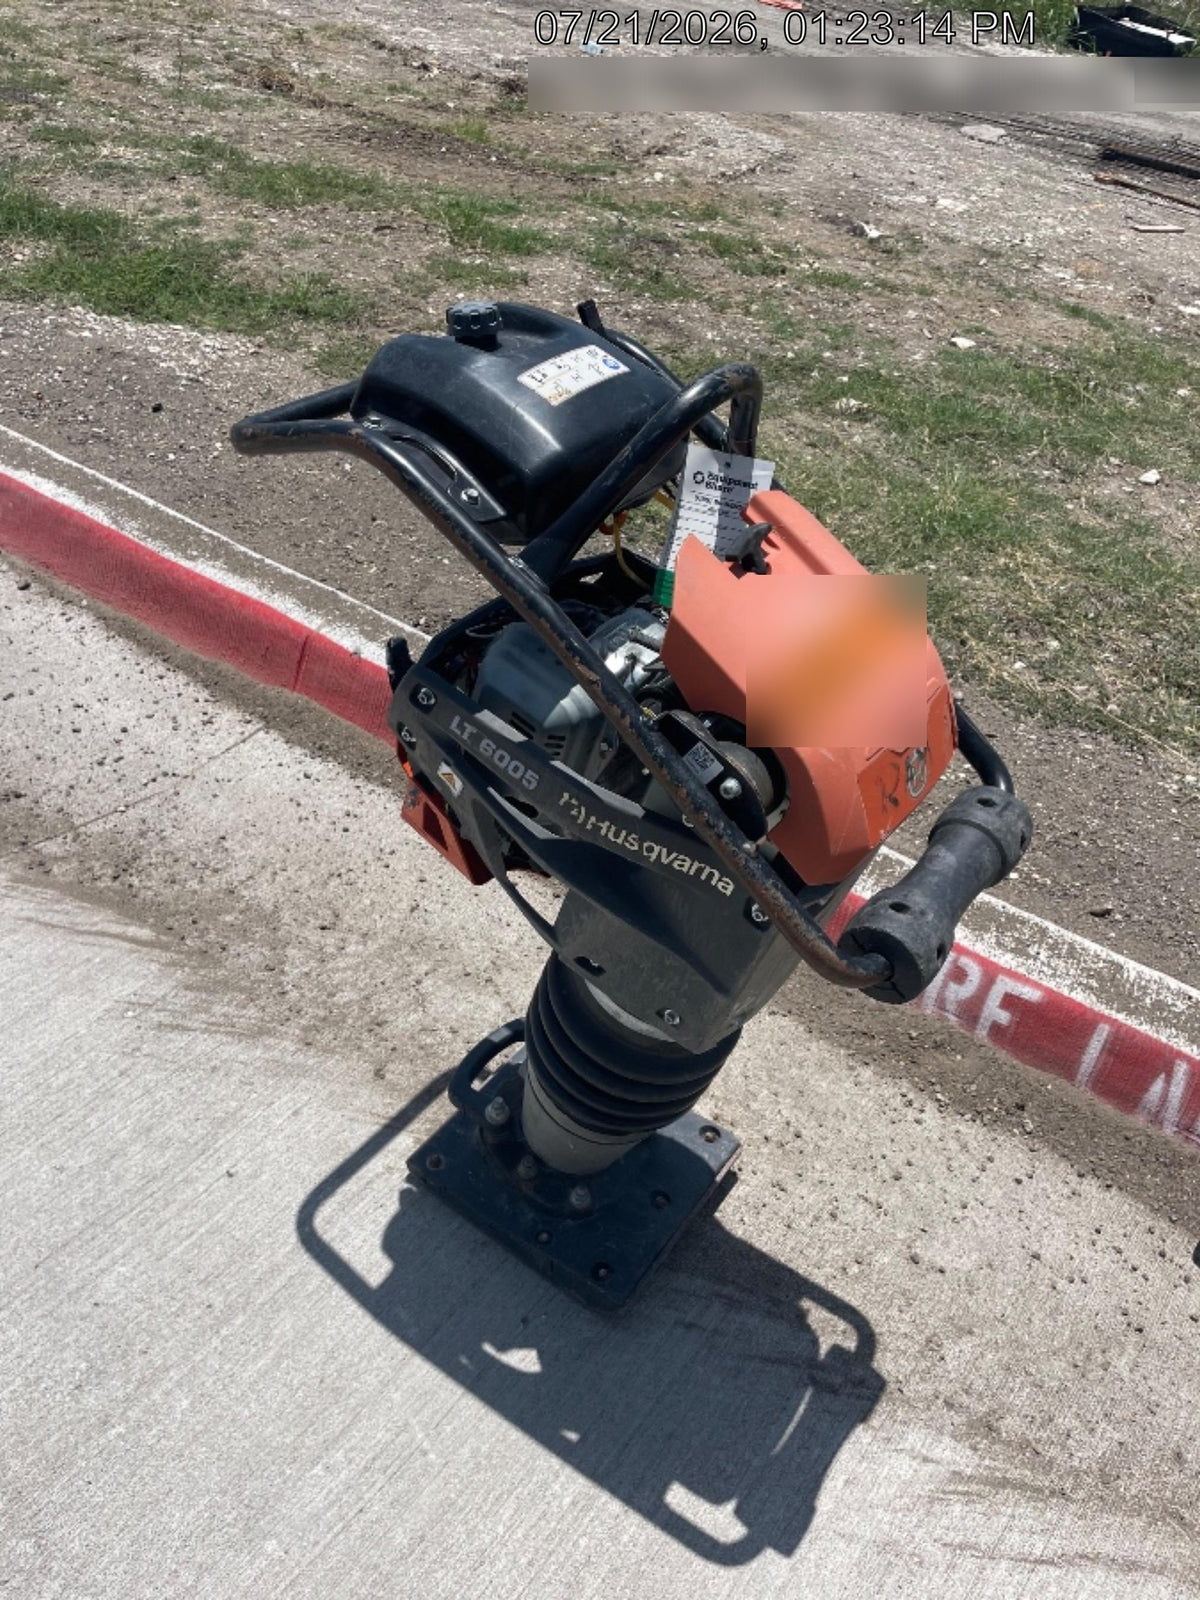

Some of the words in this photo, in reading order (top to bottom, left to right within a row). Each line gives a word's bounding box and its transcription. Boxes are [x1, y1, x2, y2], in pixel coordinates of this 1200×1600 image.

[450, 714, 478, 742] LT
[479, 740, 540, 792] 6005
[585, 815, 736, 897] Husqvarna
